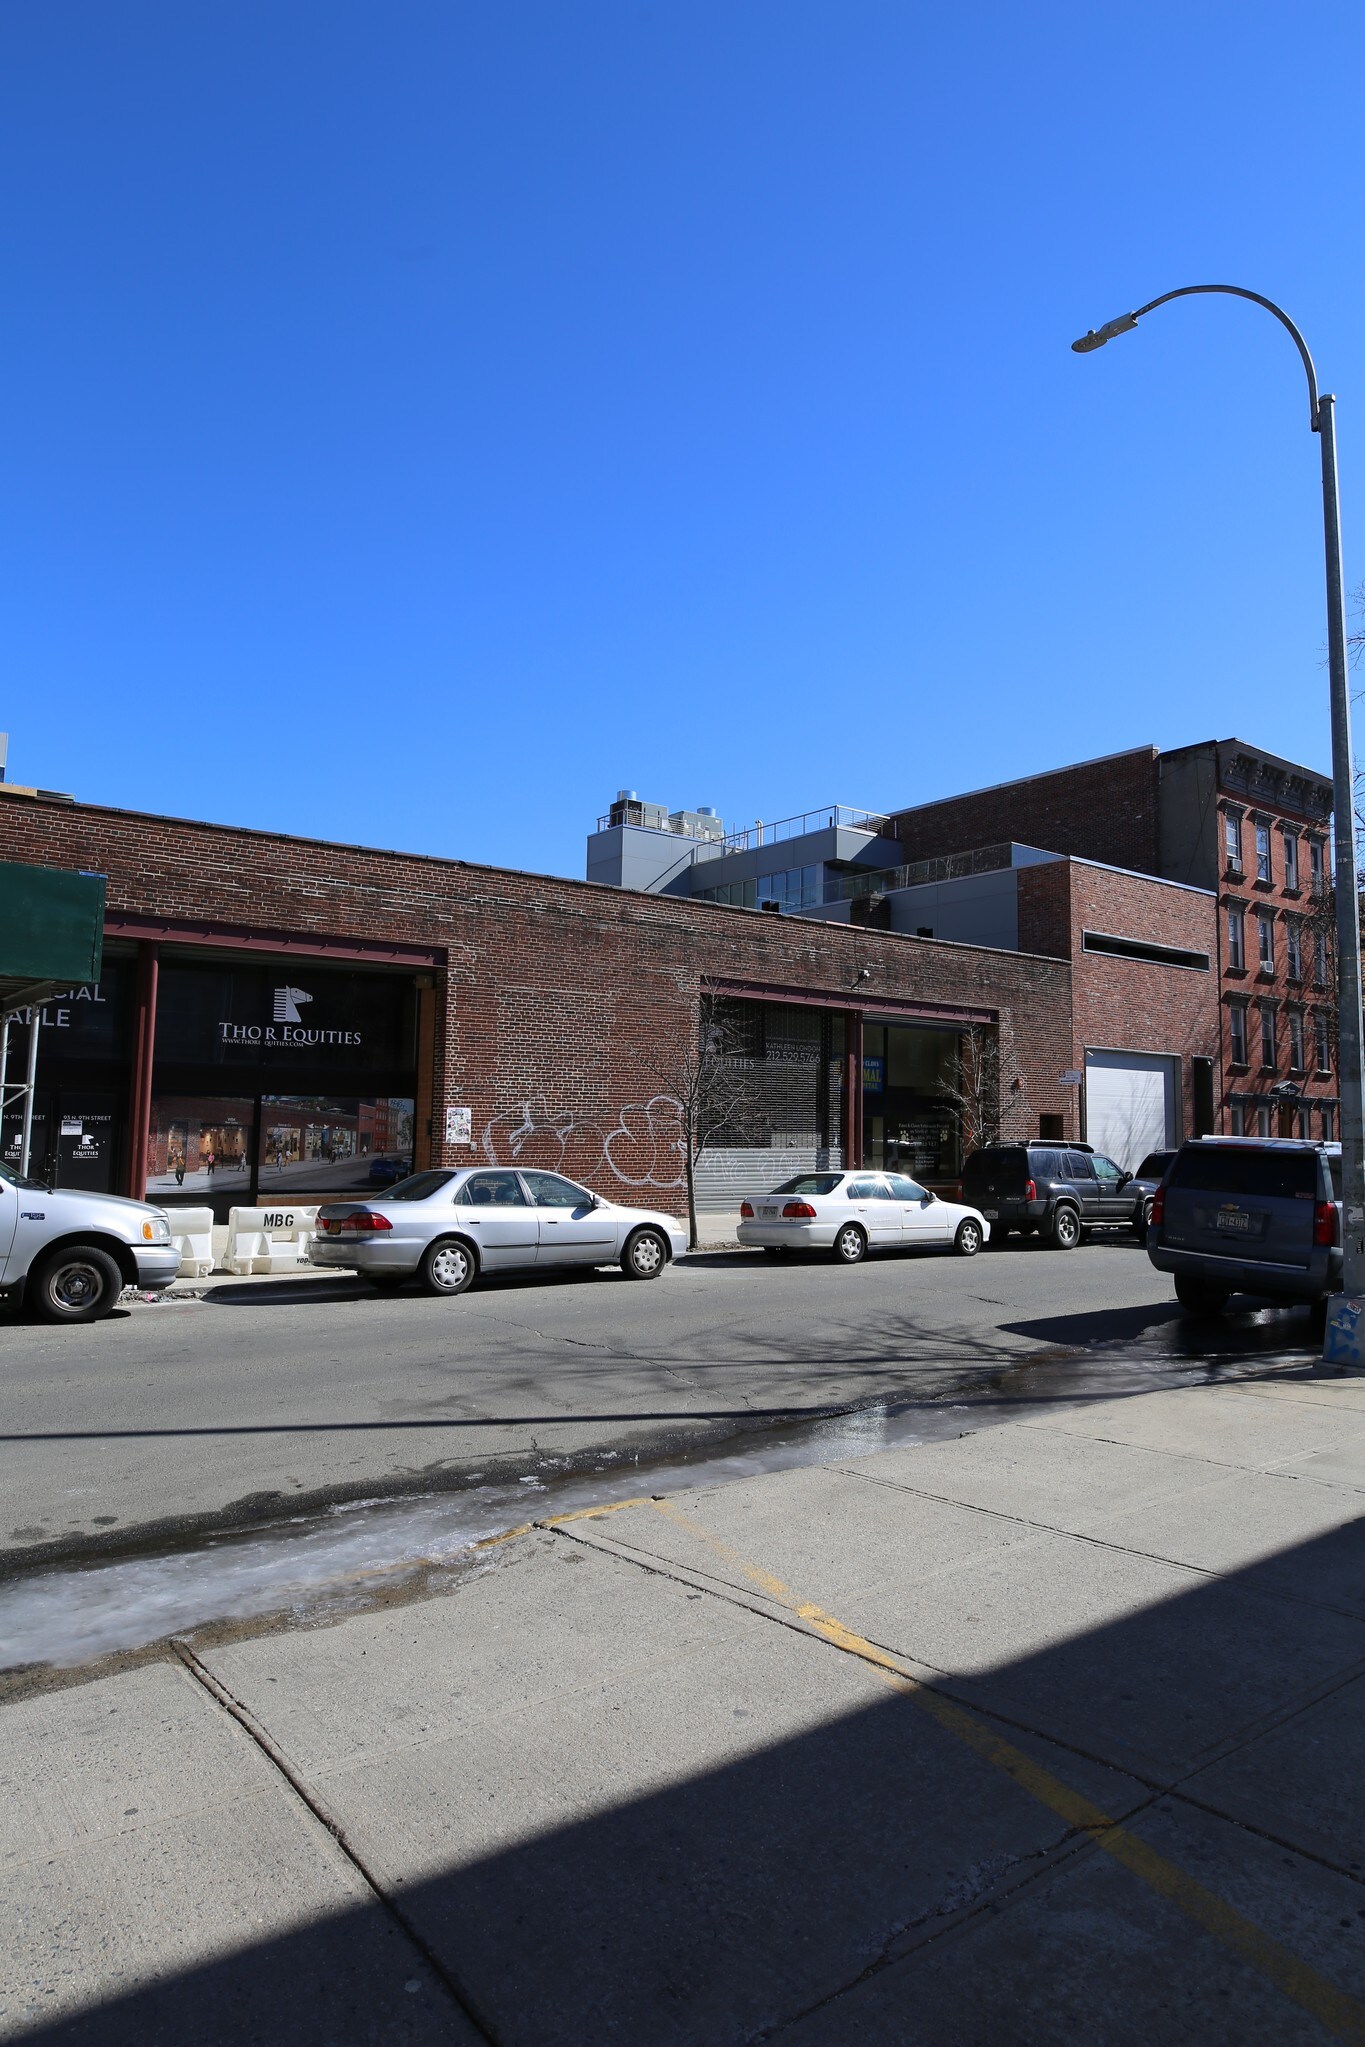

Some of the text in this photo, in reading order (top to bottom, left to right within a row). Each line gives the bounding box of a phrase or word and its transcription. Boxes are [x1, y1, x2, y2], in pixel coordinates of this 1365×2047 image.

[54, 983, 106, 1002] IAL
[283, 1026, 361, 1046] EQUITIES
[765, 1042, 795, 1051] KATHLEEN
[766, 1050, 821, 1064] 212.529.5766
[263, 1213, 294, 1227] MBG
